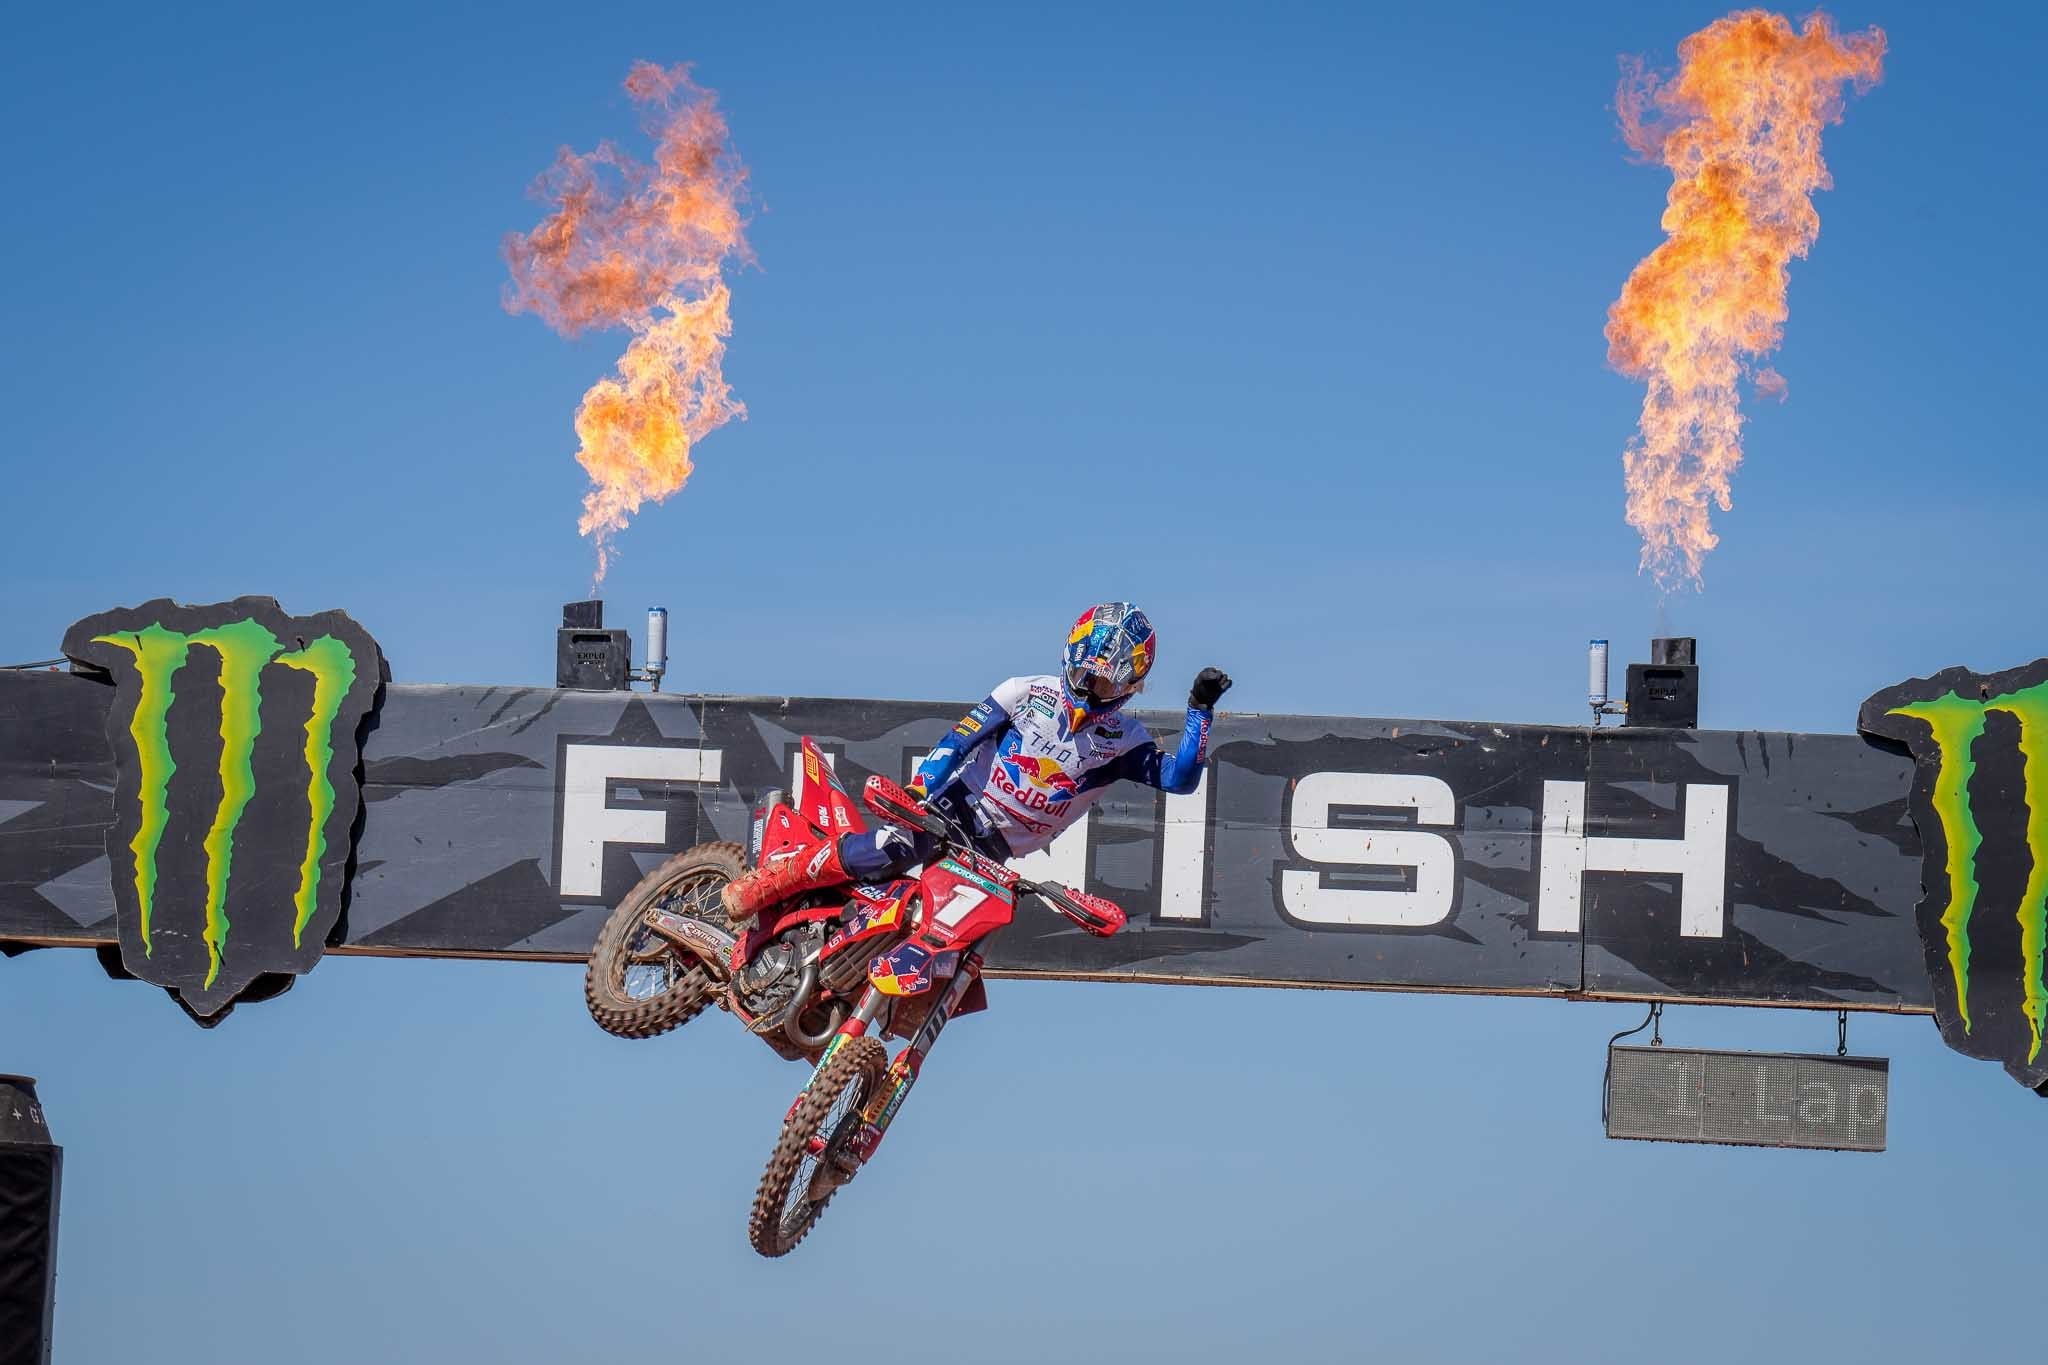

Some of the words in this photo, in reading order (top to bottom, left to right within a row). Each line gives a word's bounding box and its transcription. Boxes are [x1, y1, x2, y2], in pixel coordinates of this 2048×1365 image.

[991, 766, 1034, 806] Red
[1030, 791, 1073, 818] Bull
[949, 864, 985, 887] MOTOREX
[934, 884, 988, 928] 1
[1664, 1061, 1697, 1116] 1
[1755, 1065, 1886, 1142] Lap
